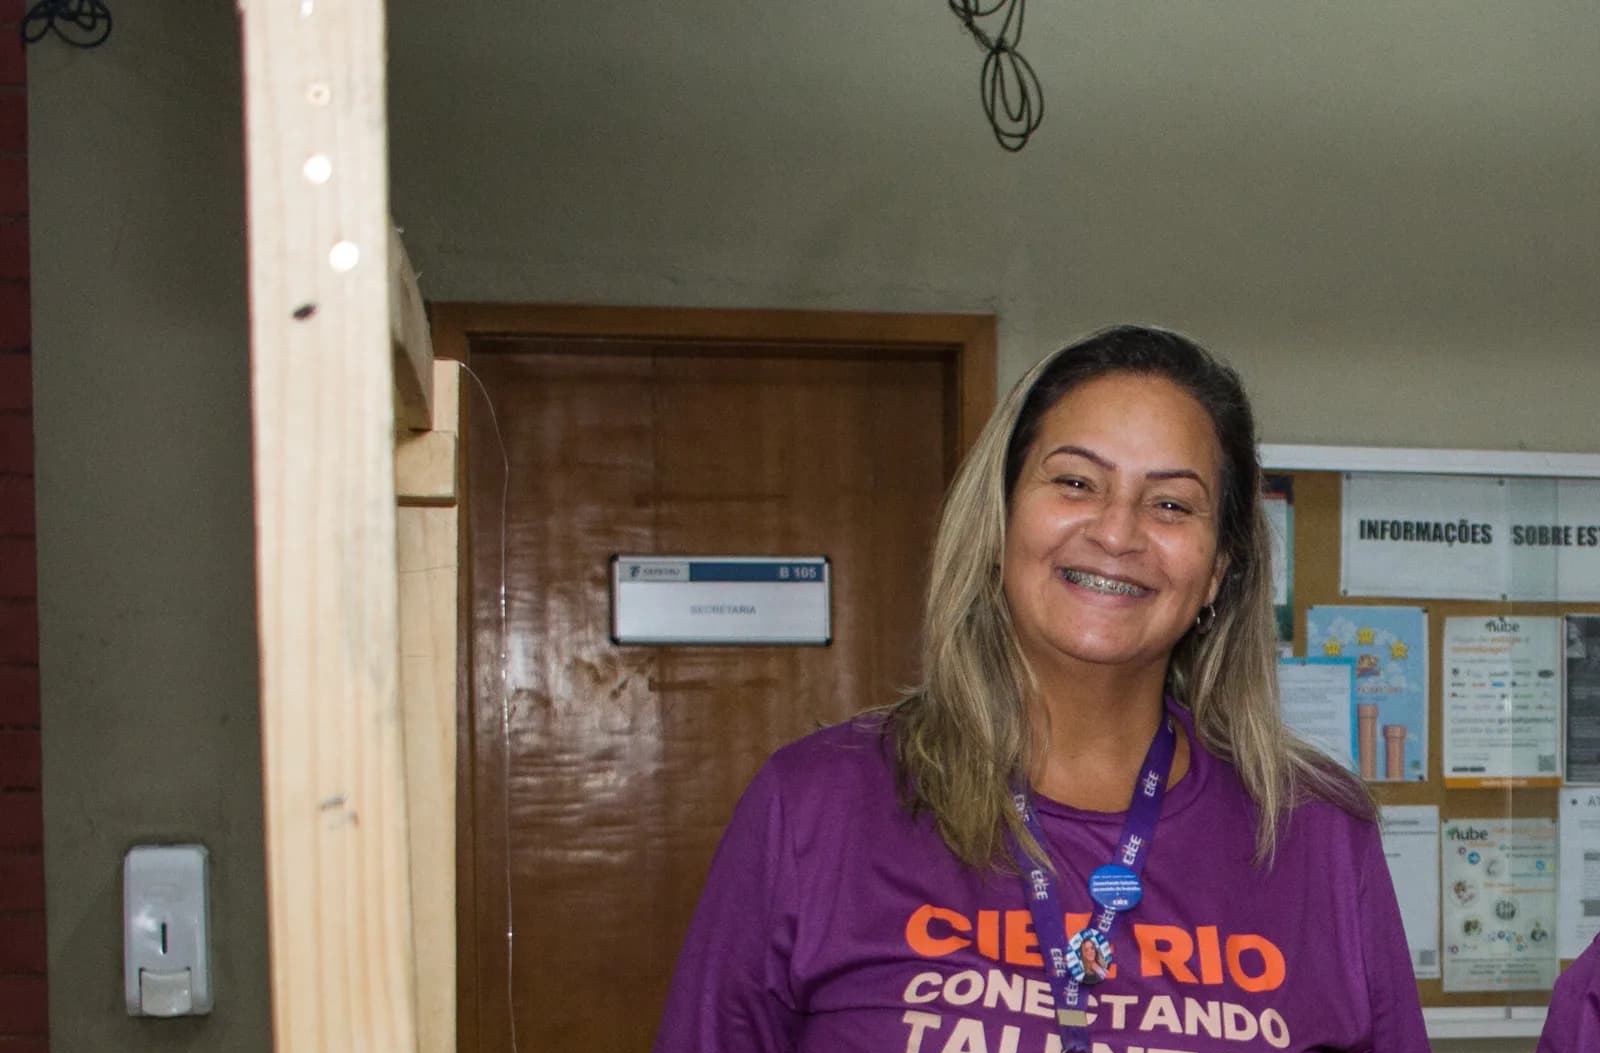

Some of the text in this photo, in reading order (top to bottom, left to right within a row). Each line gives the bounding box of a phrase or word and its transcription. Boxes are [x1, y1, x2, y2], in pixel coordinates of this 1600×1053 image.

[1359, 519, 1492, 547] INFORMAÇÕES
[1512, 525, 1573, 547] SOBRE
[778, 566, 817, 579] B 105
[690, 604, 757, 616] SECRETARIA
[1448, 826, 1488, 841] nube
[905, 904, 1287, 993] CIE RIO
[902, 970, 1291, 1049] CONETANDO
